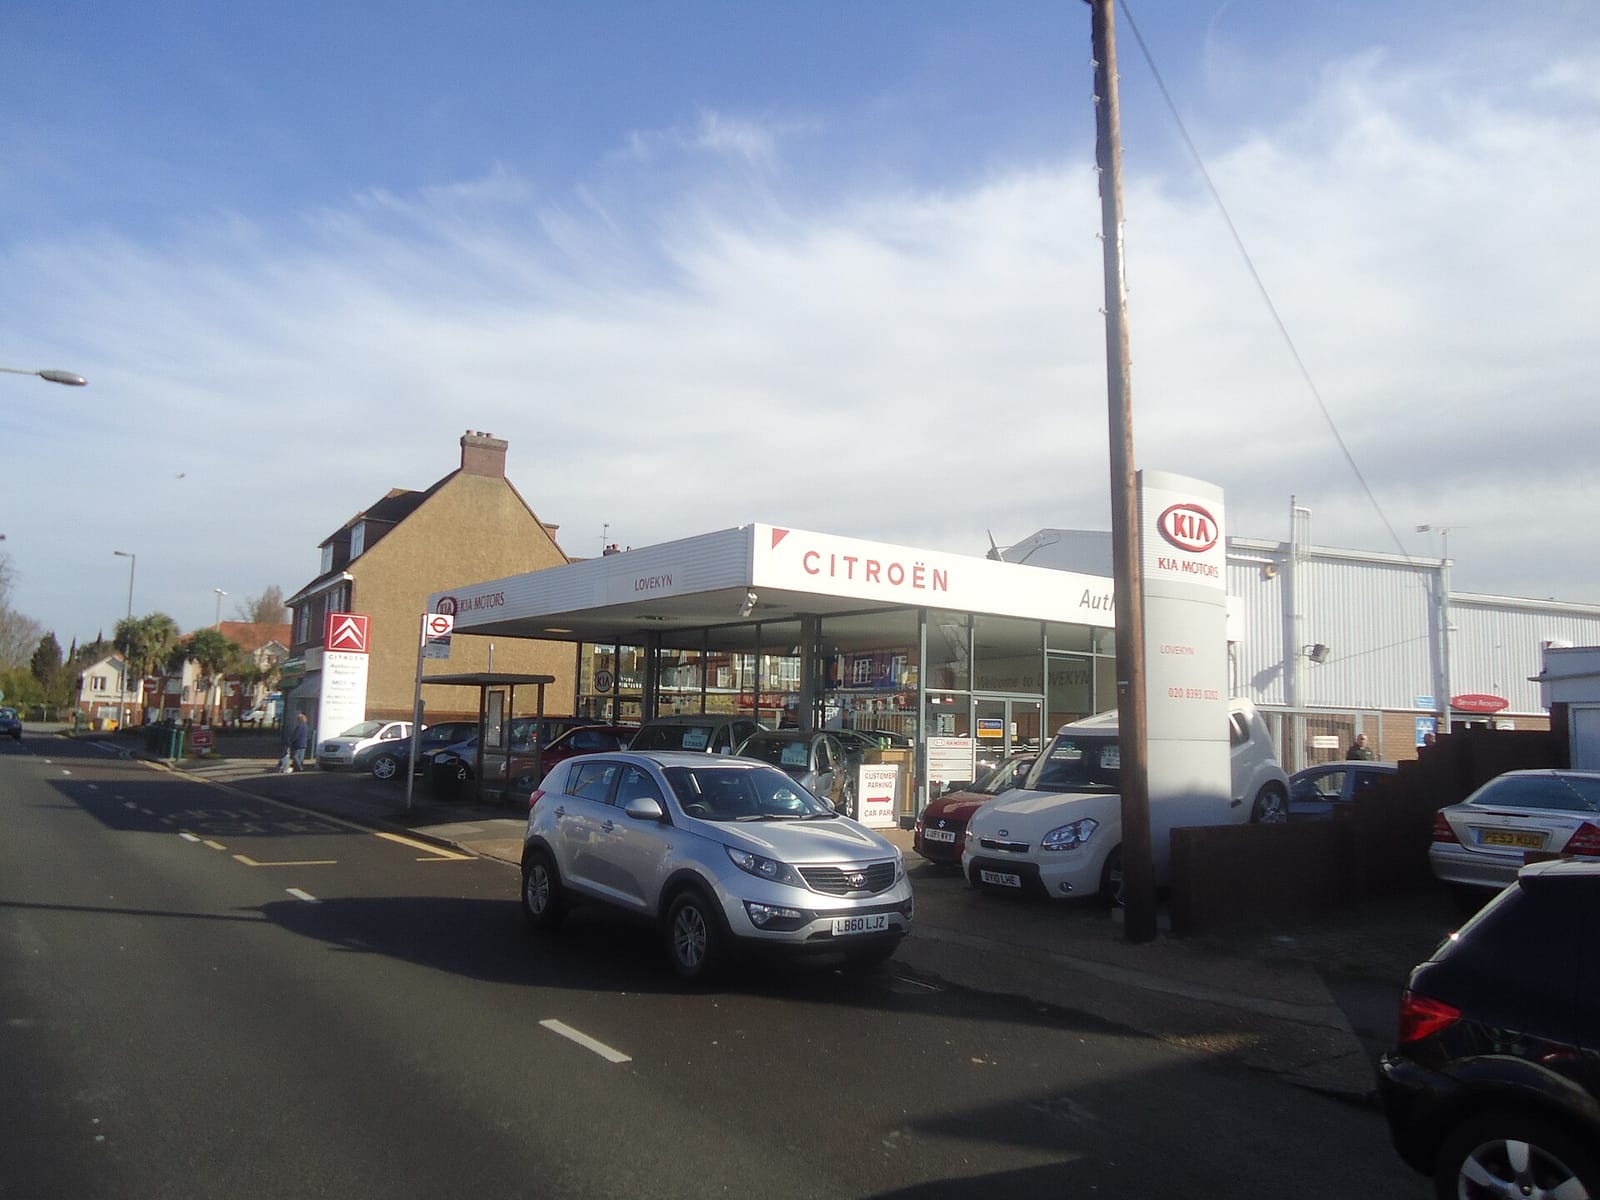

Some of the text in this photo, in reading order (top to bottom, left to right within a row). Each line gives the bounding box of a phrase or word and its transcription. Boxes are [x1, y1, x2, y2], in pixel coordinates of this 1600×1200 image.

[1174, 513, 1210, 542] KIA
[803, 551, 948, 592] CITROËN
[1158, 557, 1219, 578] KIA MOTORS
[635, 573, 673, 591] LOVEKYN
[460, 592, 505, 612] KIA MOTORS
[864, 772, 897, 780] CUSTOMER
[864, 809, 896, 817] CAR PARK
[836, 916, 885, 932] LB60 LJZ
